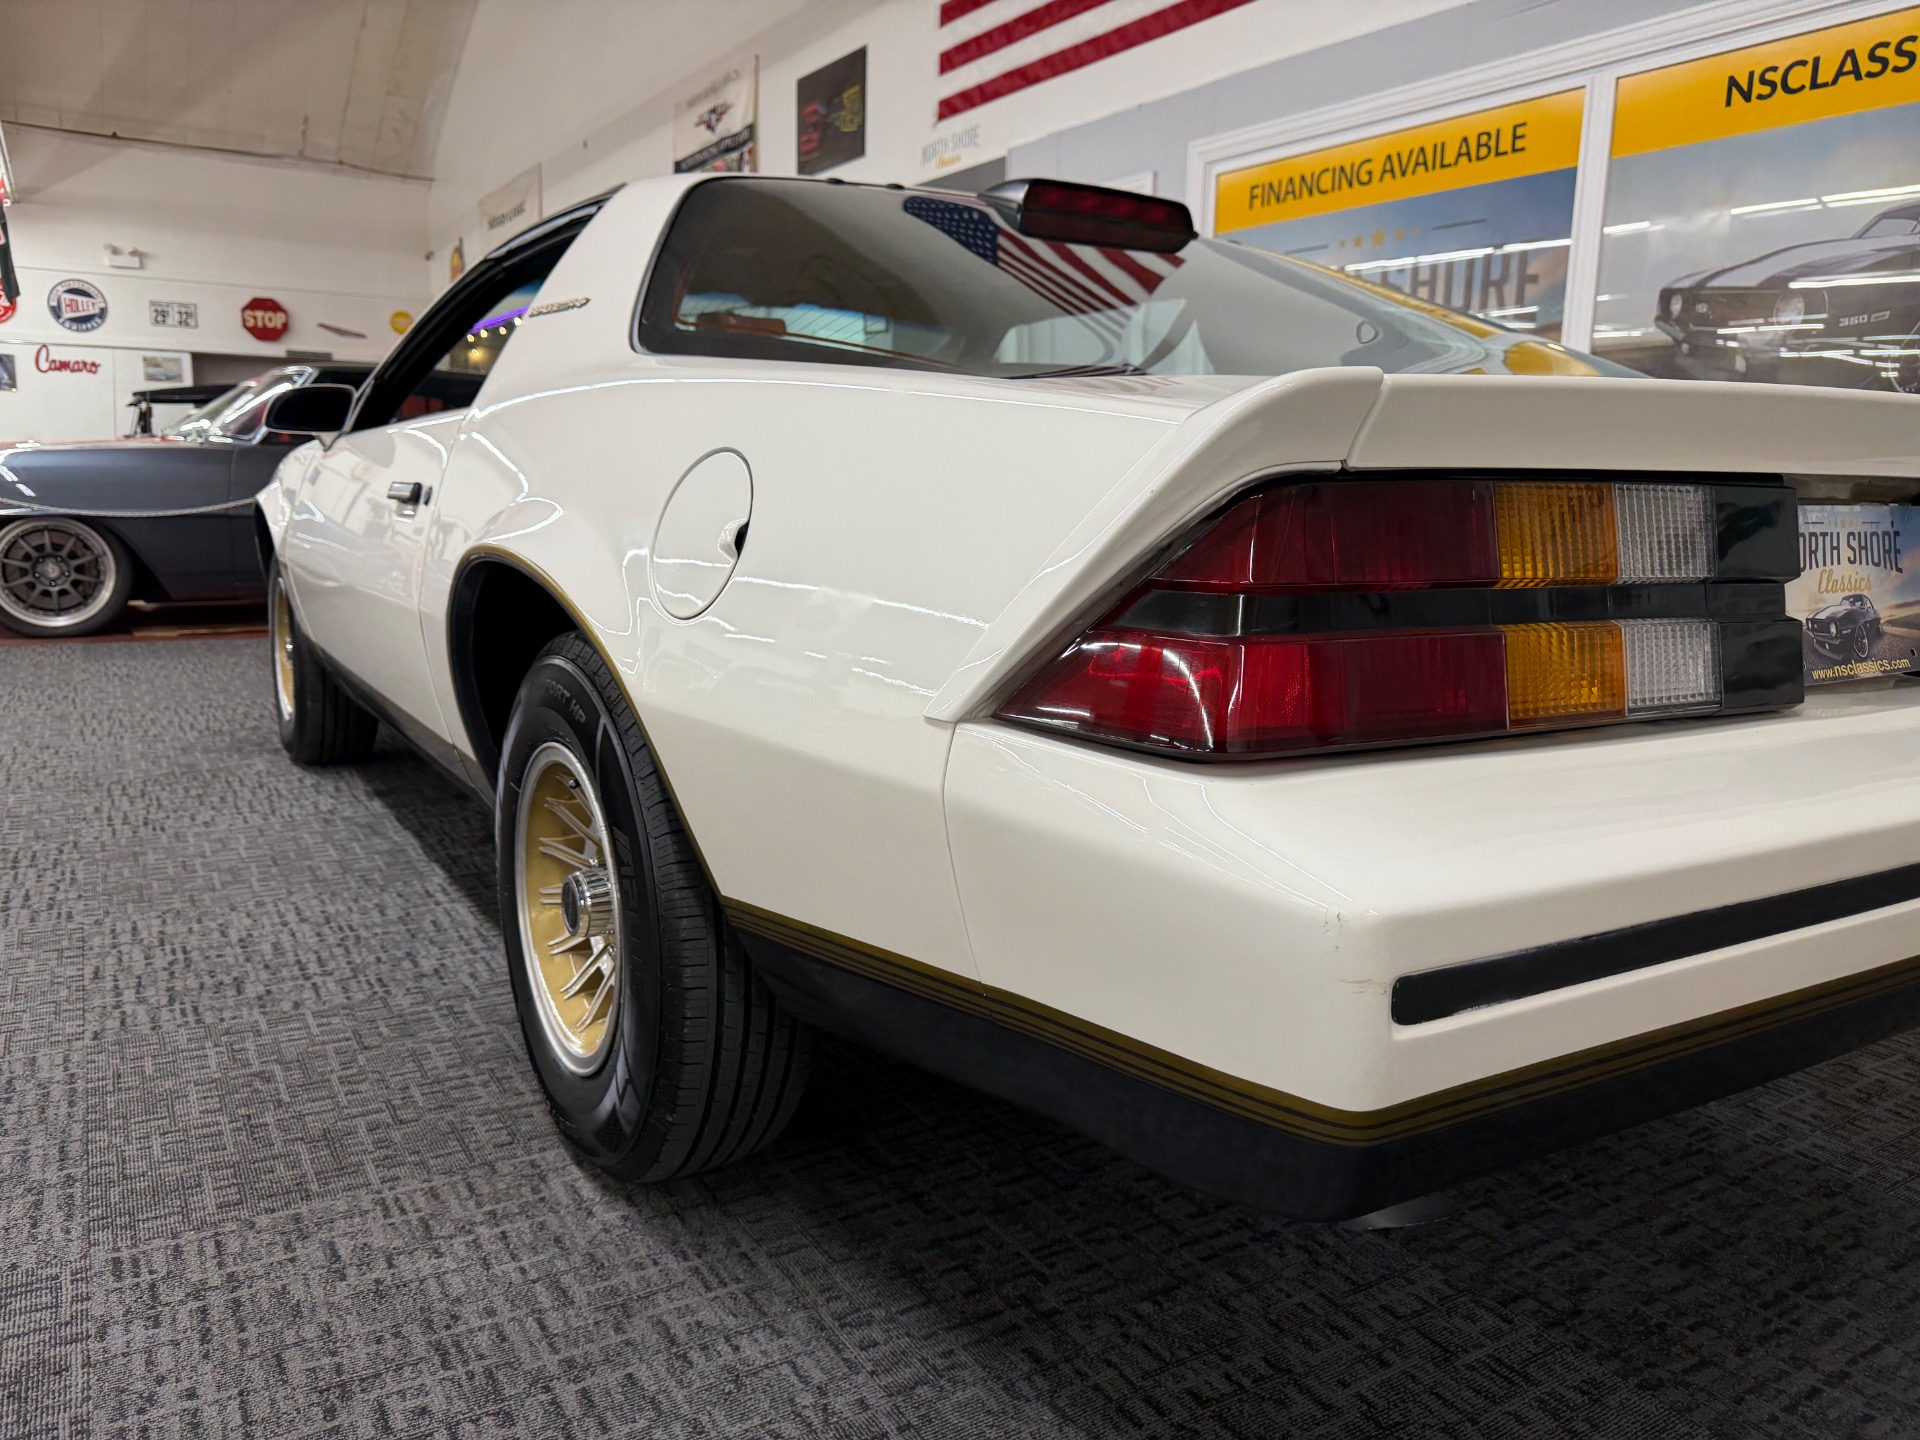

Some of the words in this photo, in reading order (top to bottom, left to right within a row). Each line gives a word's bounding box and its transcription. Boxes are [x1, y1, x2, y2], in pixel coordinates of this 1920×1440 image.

[1725, 35, 1920, 108] NSCLASS
[1248, 158, 1373, 211] FINANCING
[1378, 122, 1528, 183] AVAILABLE
[243, 308, 288, 330] STOP
[1839, 313, 1868, 328] 350
[35, 343, 102, 375] Camaro
[1799, 530, 1841, 572] ORTH
[1847, 530, 1904, 574] SHORE
[1818, 568, 1874, 595] Classics
[1811, 657, 1911, 680] www.nsclassics.com
[569, 698, 586, 724] HP
